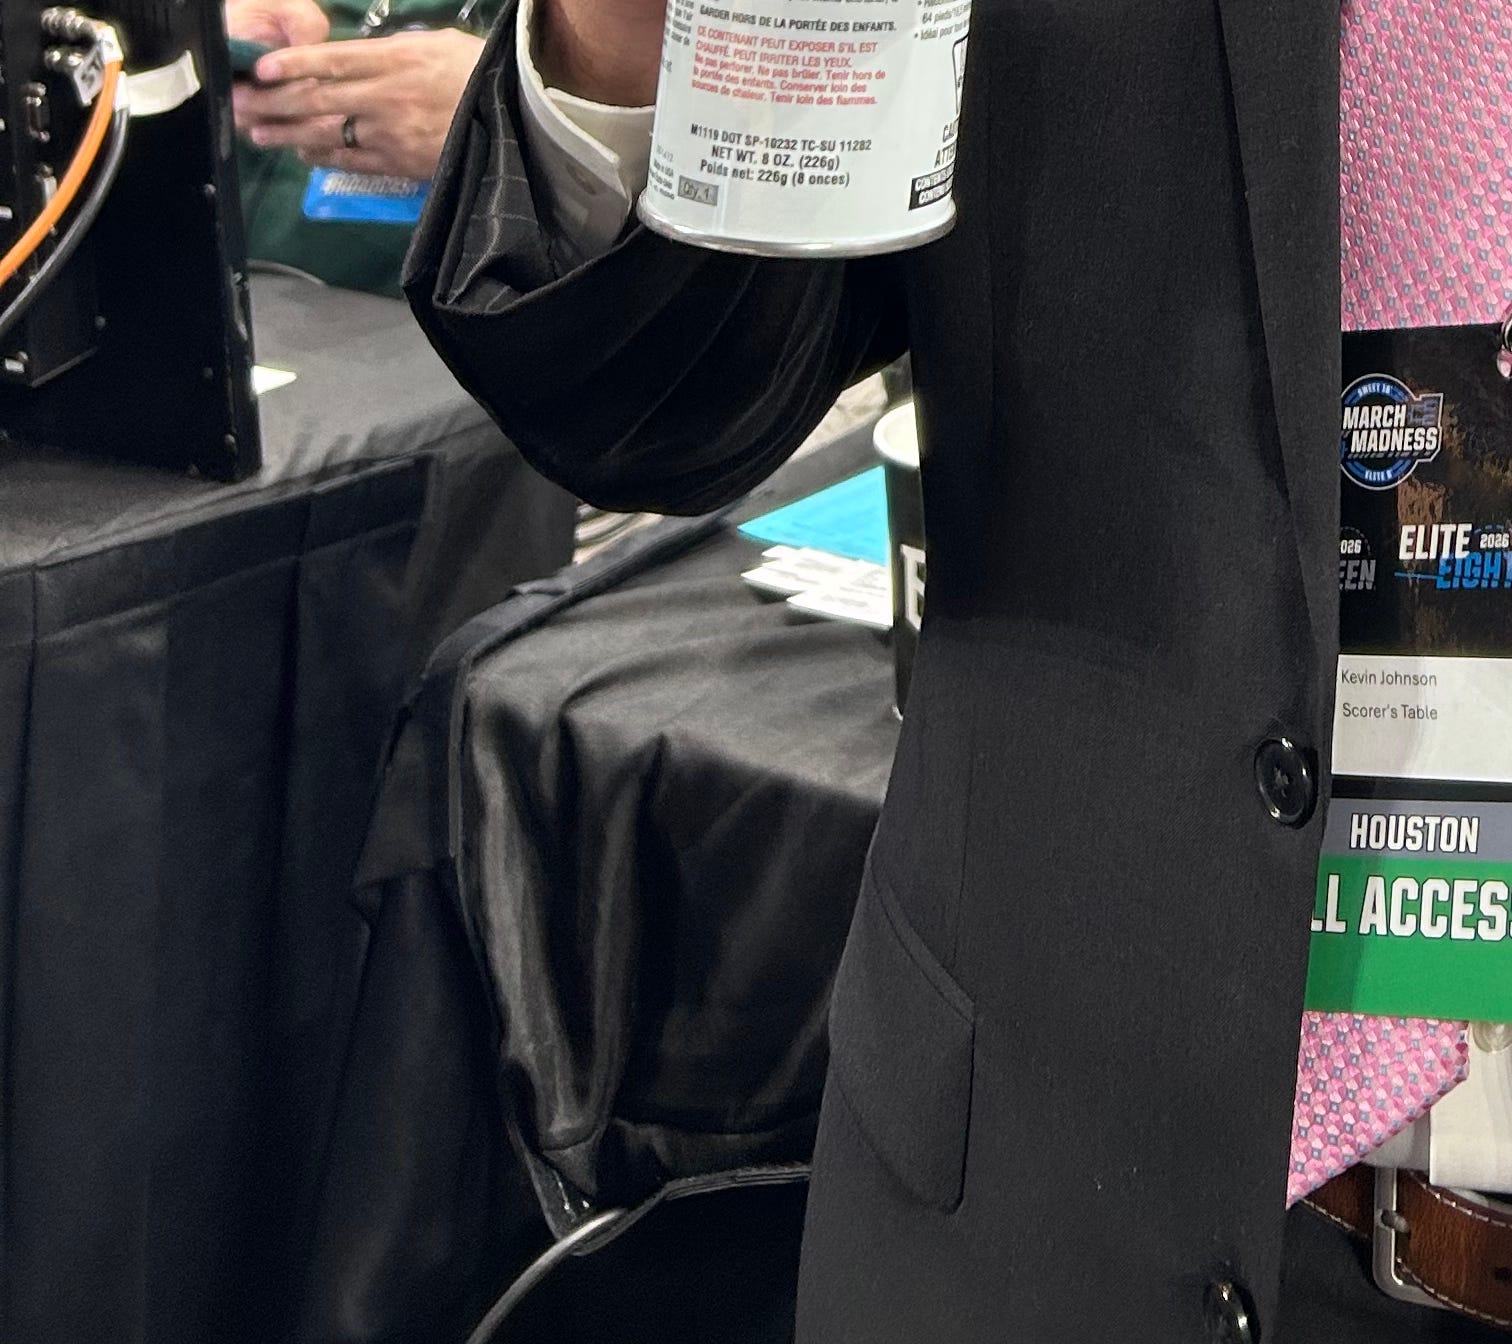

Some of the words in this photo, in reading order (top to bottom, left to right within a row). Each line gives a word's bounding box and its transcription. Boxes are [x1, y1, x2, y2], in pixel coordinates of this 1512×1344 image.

[760, 16, 771, 26] DE
[774, 16, 786, 28] LA
[789, 18, 827, 31] PORTÉE
[830, 21, 849, 32] DES
[853, 21, 896, 32] ENFANTS.
[761, 37, 786, 50] PEUT
[789, 40, 835, 52] EXPOSER
[859, 42, 877, 53] EST
[733, 49, 757, 62] PEUT
[802, 56, 820, 67] LES
[826, 69, 849, 80] Tenir
[780, 80, 827, 92] Conserver
[771, 92, 794, 103] Tenir
[722, 130, 742, 145] DOT
[801, 140, 836, 152] TC-SU
[712, 145, 732, 159] NET
[736, 150, 758, 164] WT.
[762, 153, 769, 165] 8
[773, 154, 794, 167] OZ.
[799, 155, 840, 171] (226g)
[700, 160, 729, 176] Poids
[732, 166, 754, 181] net:
[758, 169, 788, 185] 226g
[792, 173, 804, 187] (8
[809, 173, 849, 187] onces)
[1343, 405, 1406, 430] MARCH
[1350, 427, 1438, 452] MADNESS
[1340, 539, 1361, 554] 026
[1399, 524, 1472, 559] ELITE
[1480, 533, 1509, 549] 2026
[1341, 668, 1377, 685] Kevin
[1380, 670, 1437, 686] Johnson
[1342, 702, 1398, 719] Scorer's
[1401, 704, 1438, 720] Table
[1350, 813, 1480, 854] HOUSTON
